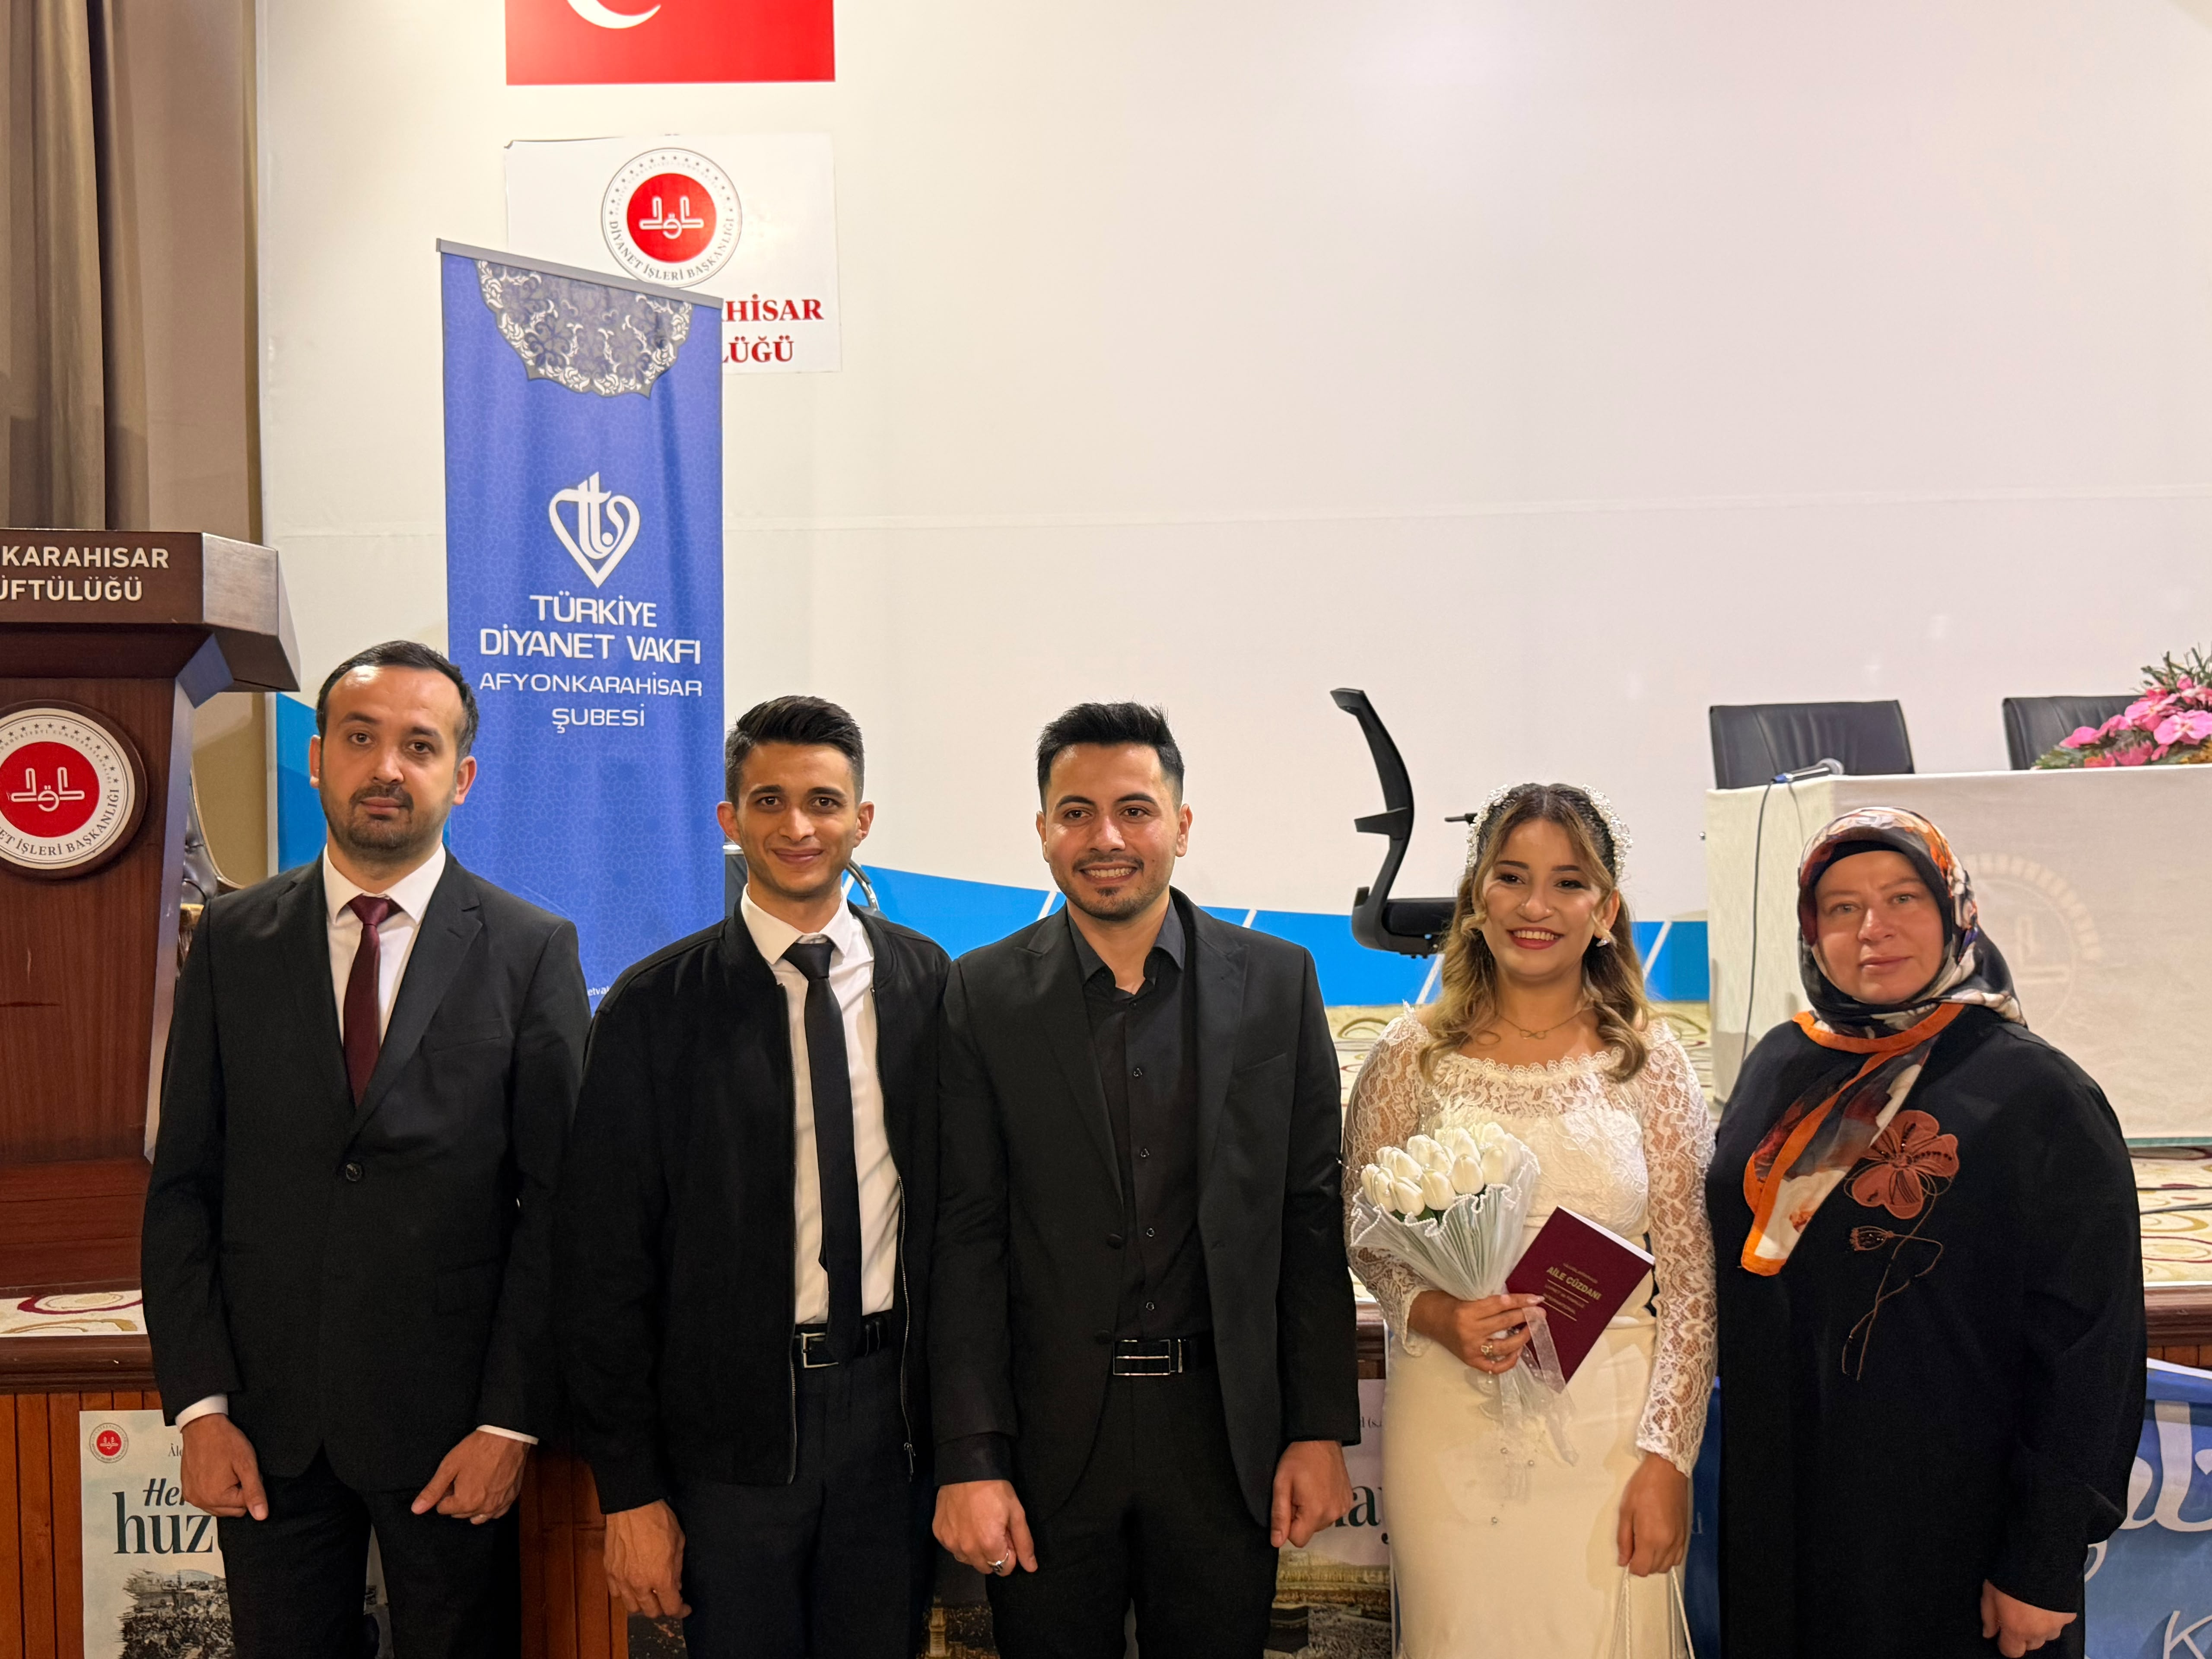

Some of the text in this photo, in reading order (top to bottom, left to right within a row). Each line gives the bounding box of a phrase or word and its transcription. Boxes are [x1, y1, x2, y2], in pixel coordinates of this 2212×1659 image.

[610, 221, 643, 269] DİYANET
[643, 264, 684, 280] İŞLERİ
[722, 294, 824, 321] HİSAR
[2, 546, 169, 569] KARAHISAR
[530, 591, 657, 628] TÜRKİYE
[480, 624, 701, 664] DİYANET VAKFI
[479, 671, 702, 696] AFYONKARAHİSAR
[552, 703, 645, 734] ŞUBESİ
[16, 839, 63, 855] İŞLERİ
[66, 788, 119, 853] BAŞKANLIĞI
[1546, 1266, 1567, 1281] AİLE
[1566, 1277, 1602, 1300] CÜZDANI
